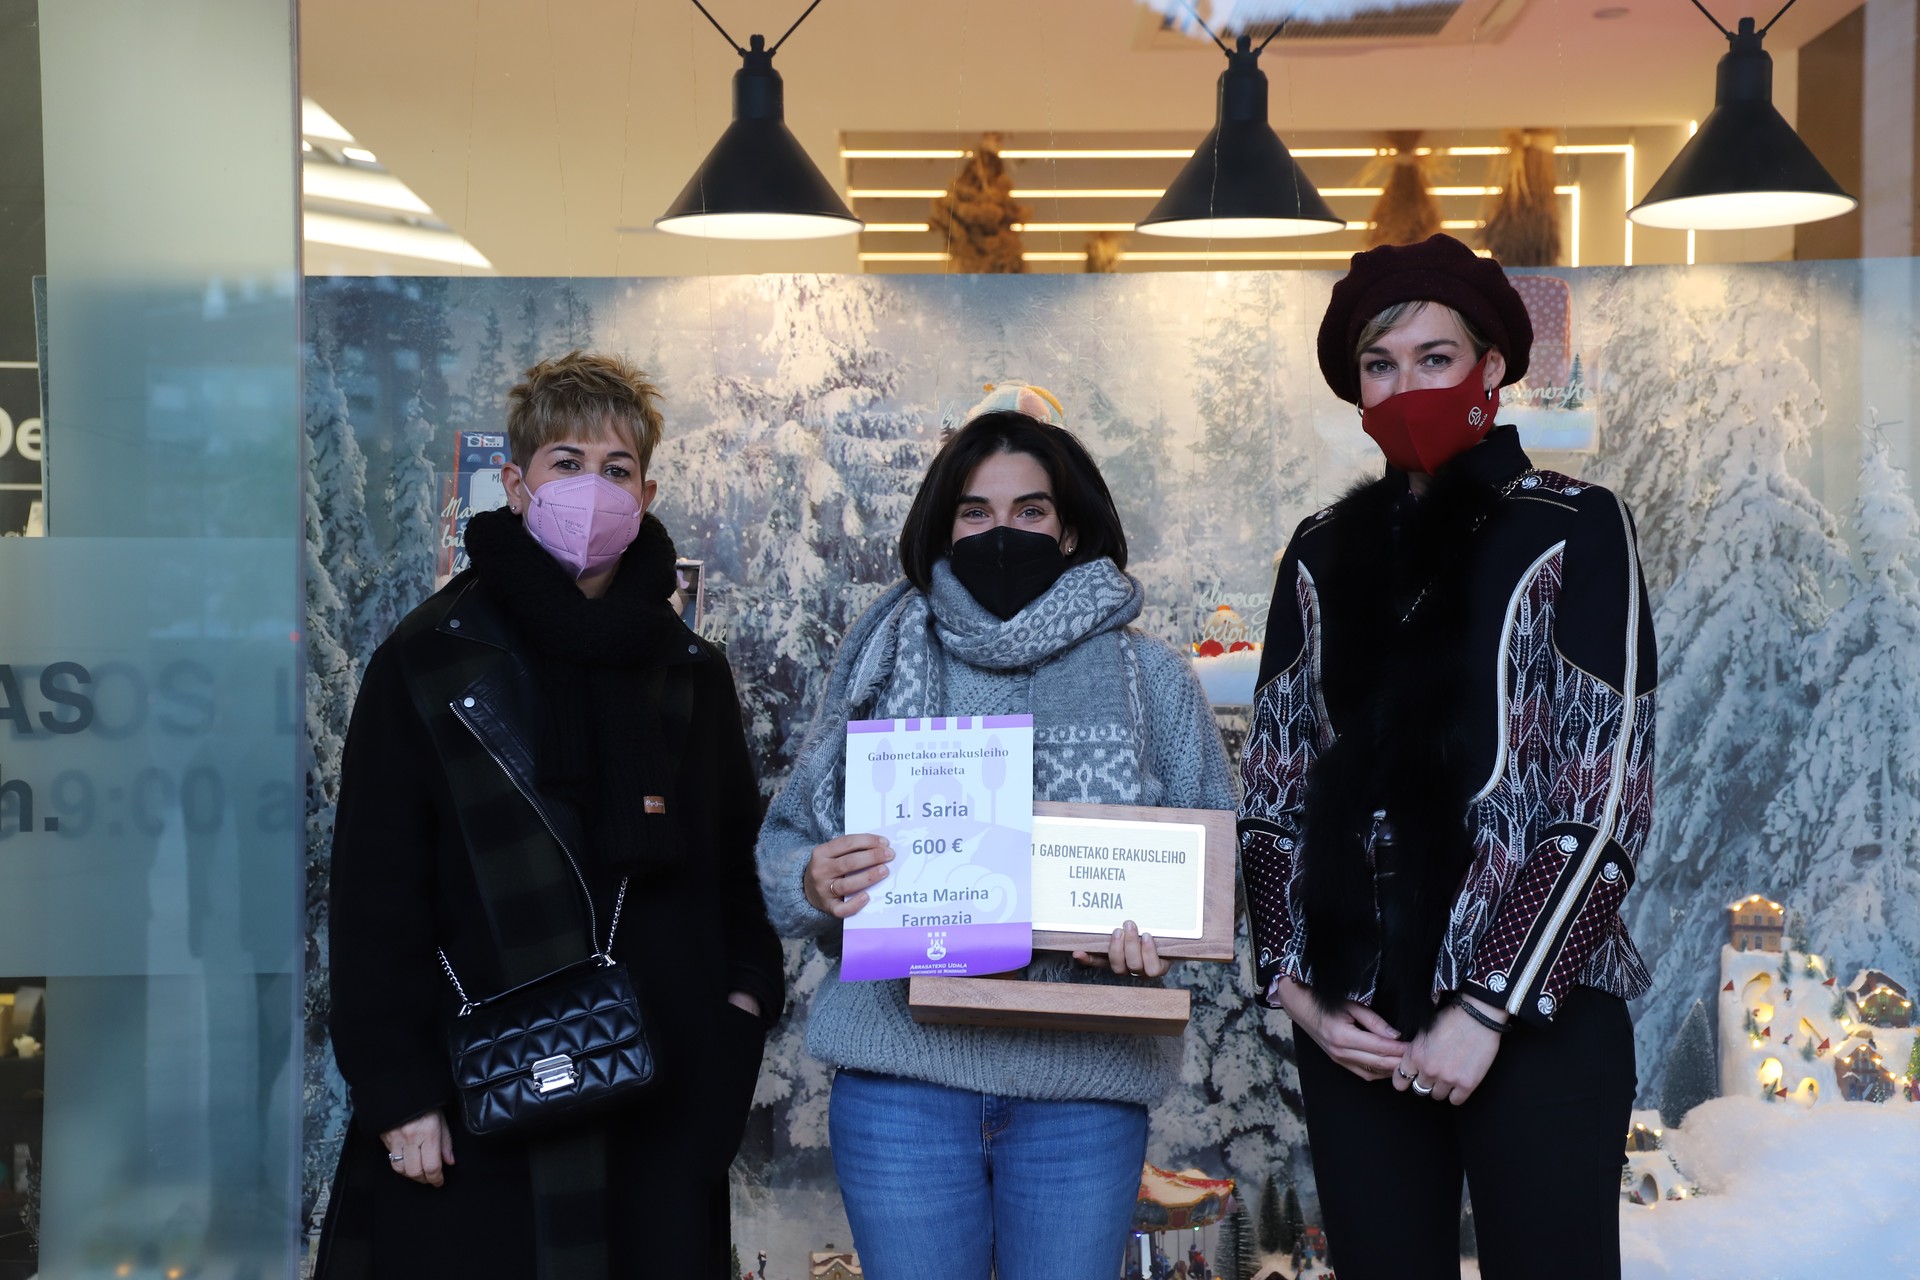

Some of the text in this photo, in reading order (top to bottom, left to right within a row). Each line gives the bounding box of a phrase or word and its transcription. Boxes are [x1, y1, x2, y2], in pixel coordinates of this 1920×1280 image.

[868, 748, 1009, 762] Gabonetako erakusleiho
[911, 766, 965, 776] lehiaketa
[895, 801, 968, 819] 1. Saria
[912, 838, 963, 855] 600 €
[1039, 843, 1109, 860] GABONETAKO
[1112, 847, 1186, 865] ERAKUSLEIHO
[1069, 865, 1126, 882] LEHIAKETA
[884, 886, 989, 905] Santa Marina
[1070, 890, 1124, 910] 1.SARIA
[902, 911, 972, 927] Farmazia
